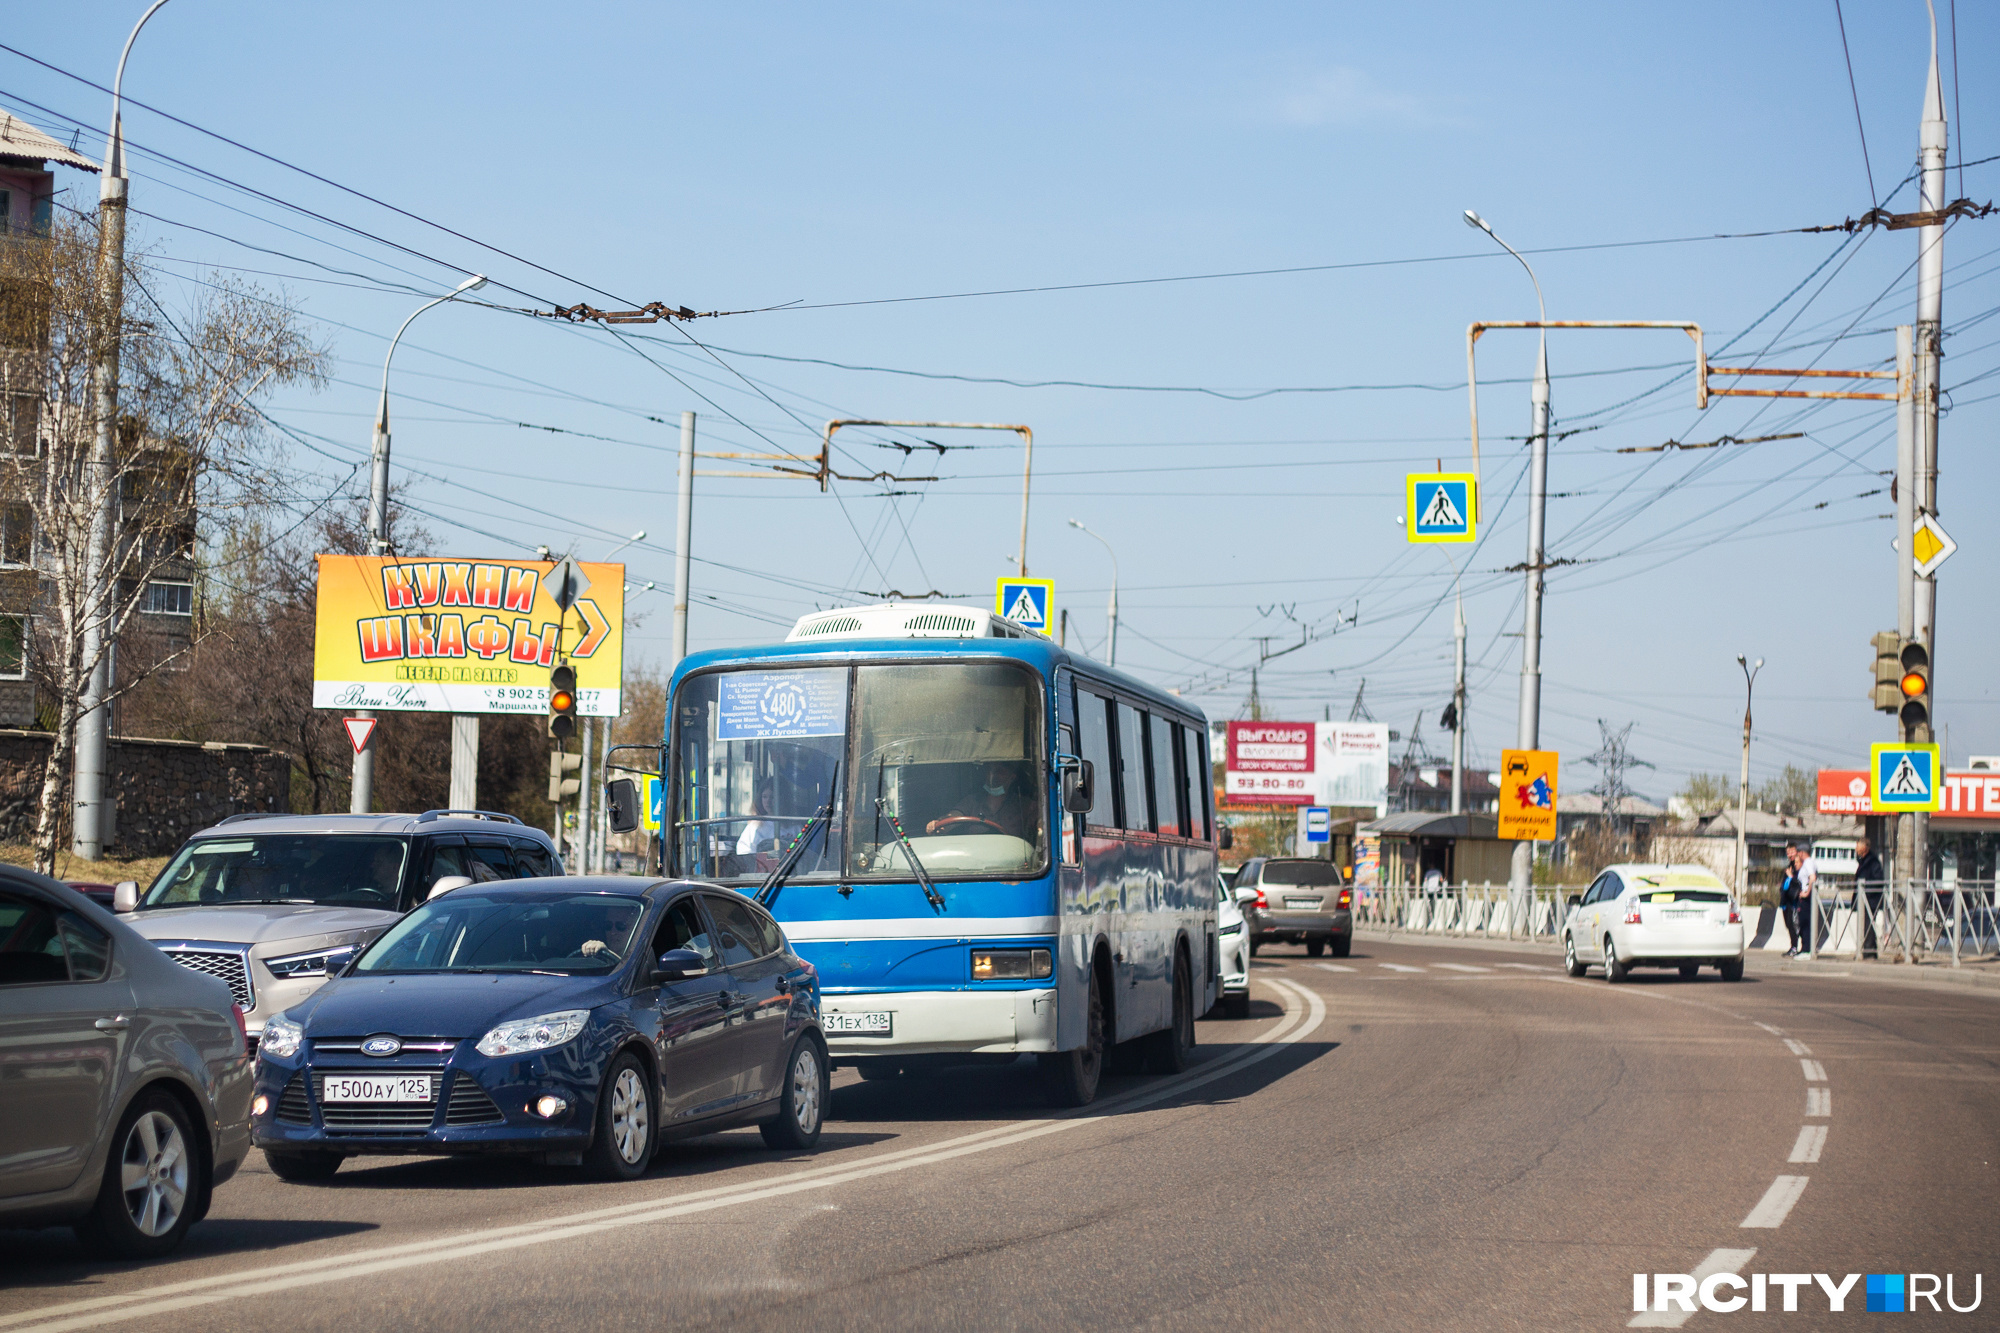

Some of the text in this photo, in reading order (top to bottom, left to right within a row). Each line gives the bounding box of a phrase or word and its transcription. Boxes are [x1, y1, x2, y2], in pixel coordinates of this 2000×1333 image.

[382, 562, 539, 613] КУХНИ
[357, 613, 560, 668] ШКАФЫ
[396, 665, 518, 683] МЕБЕЛЬ НА ЗАКАЗ
[763, 674, 805, 682] Аэропорт
[333, 683, 427, 707] Ваш Уют
[497, 688, 505, 699] 8
[509, 689, 533, 700] 902
[489, 701, 538, 712] Маршала
[586, 703, 598, 713] 16
[770, 692, 796, 717] 480
[756, 728, 808, 737] ЖК Луговое
[1237, 728, 1307, 743] ВЫГОДНО
[1820, 794, 1873, 812] СОВЕТС
[1504, 815, 1551, 825] ВНИМАНИЕ
[1515, 828, 1540, 840] ДЕТИ
[865, 1014, 885, 1025] 138
[369, 1040, 391, 1051] Ford
[399, 1079, 425, 1093] 125
